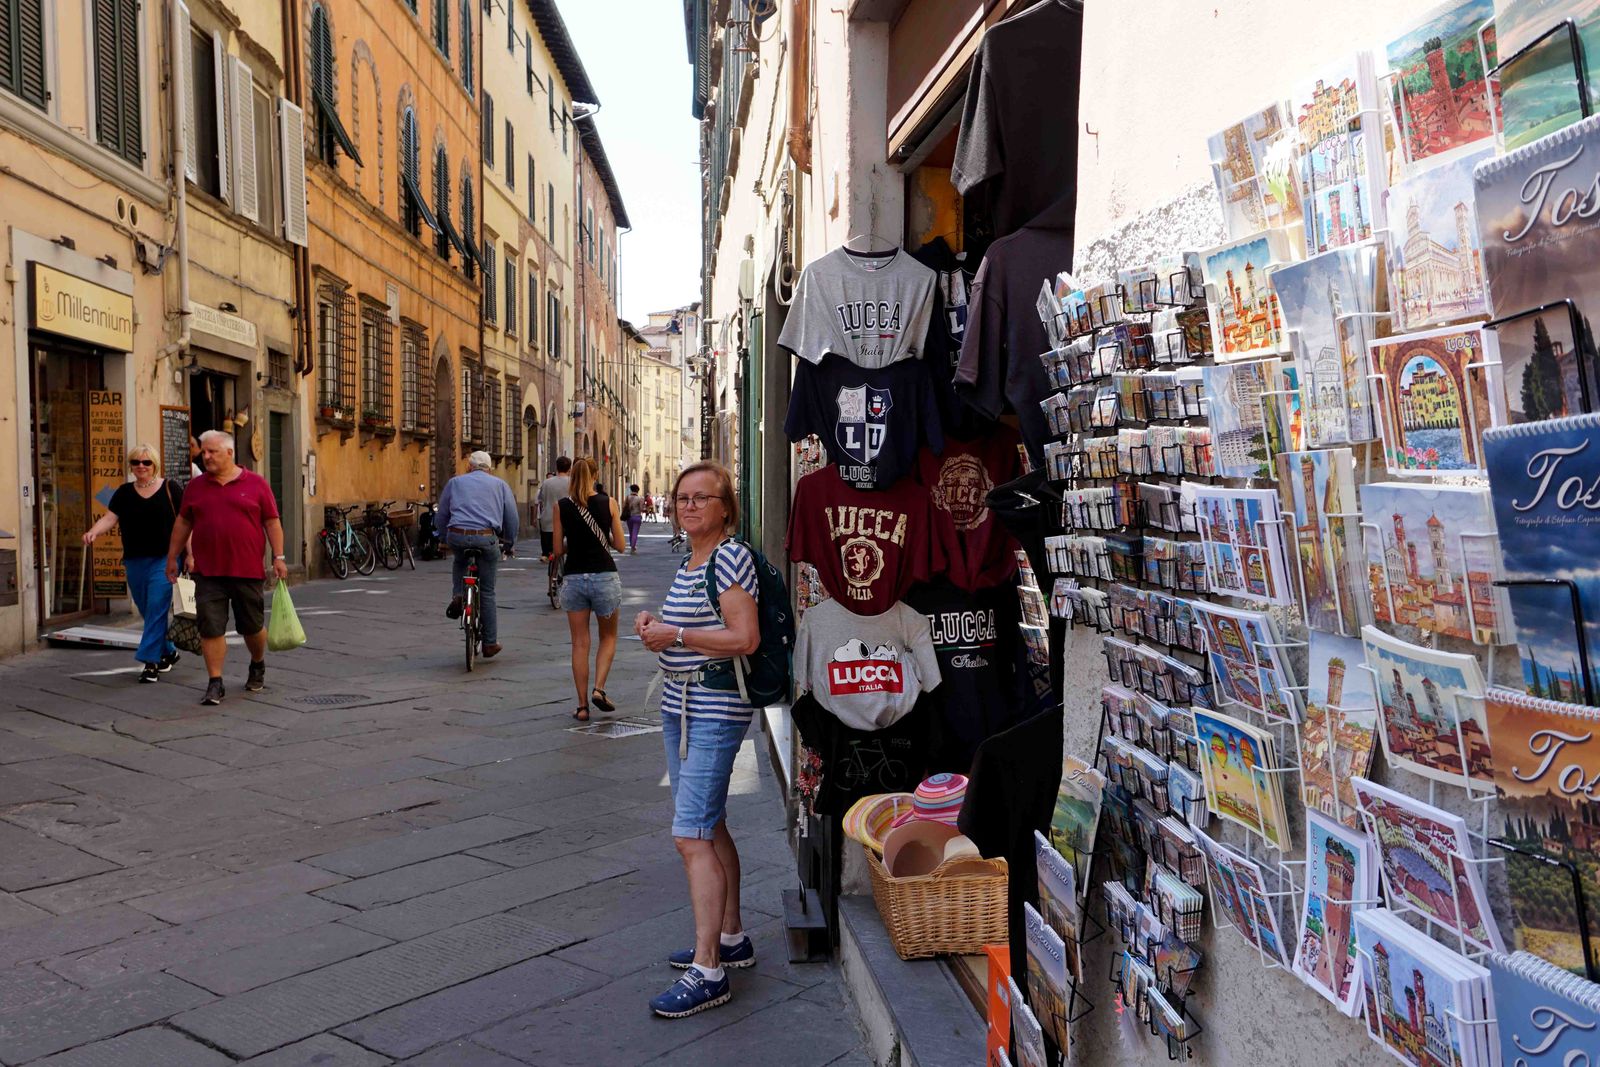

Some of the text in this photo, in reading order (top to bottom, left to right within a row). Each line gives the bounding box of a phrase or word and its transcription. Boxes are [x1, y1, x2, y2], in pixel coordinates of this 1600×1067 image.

[836, 300, 903, 335] LUCCA
[1444, 334, 1480, 353] LUCCA
[90, 391, 122, 406] BAR
[92, 438, 123, 446] GLUTEN
[92, 446, 123, 455] FREE
[92, 454, 123, 463] FOOD
[92, 467, 124, 478] PIZZA
[825, 506, 907, 548] LUCCA
[928, 608, 998, 645] LUCCA
[832, 664, 900, 685] LUCCA
[858, 683, 884, 692] ITALIA
